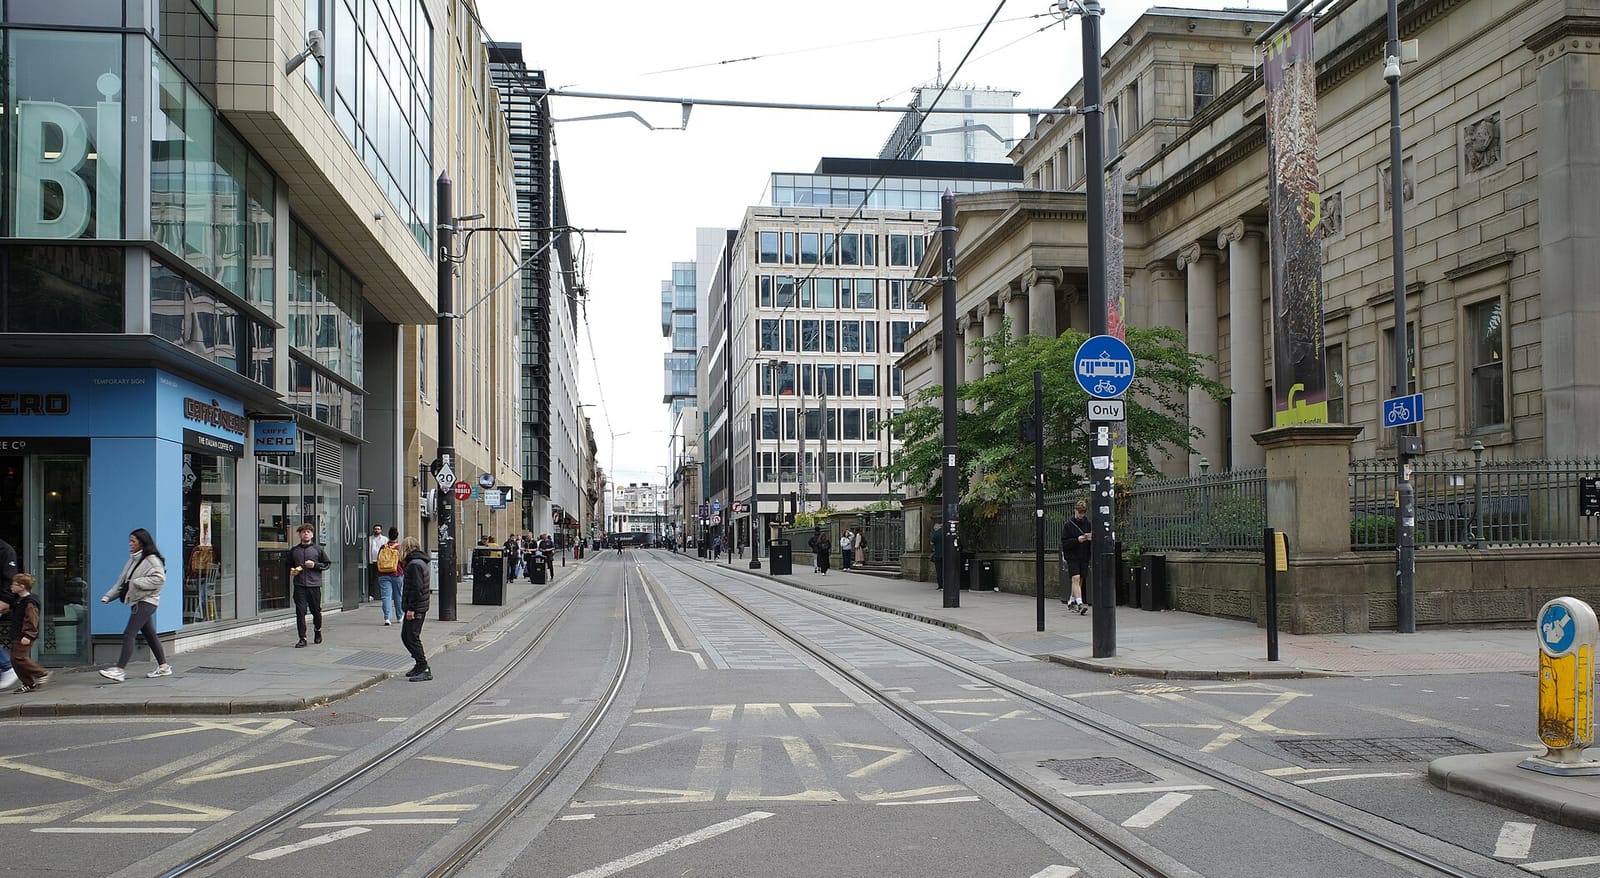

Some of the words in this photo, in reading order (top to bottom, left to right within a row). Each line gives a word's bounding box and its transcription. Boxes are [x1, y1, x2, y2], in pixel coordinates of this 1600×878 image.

[1093, 405, 1120, 417] Only
[256, 437, 294, 446] NERO
[438, 473, 454, 483] 20
[344, 504, 357, 546] 80
